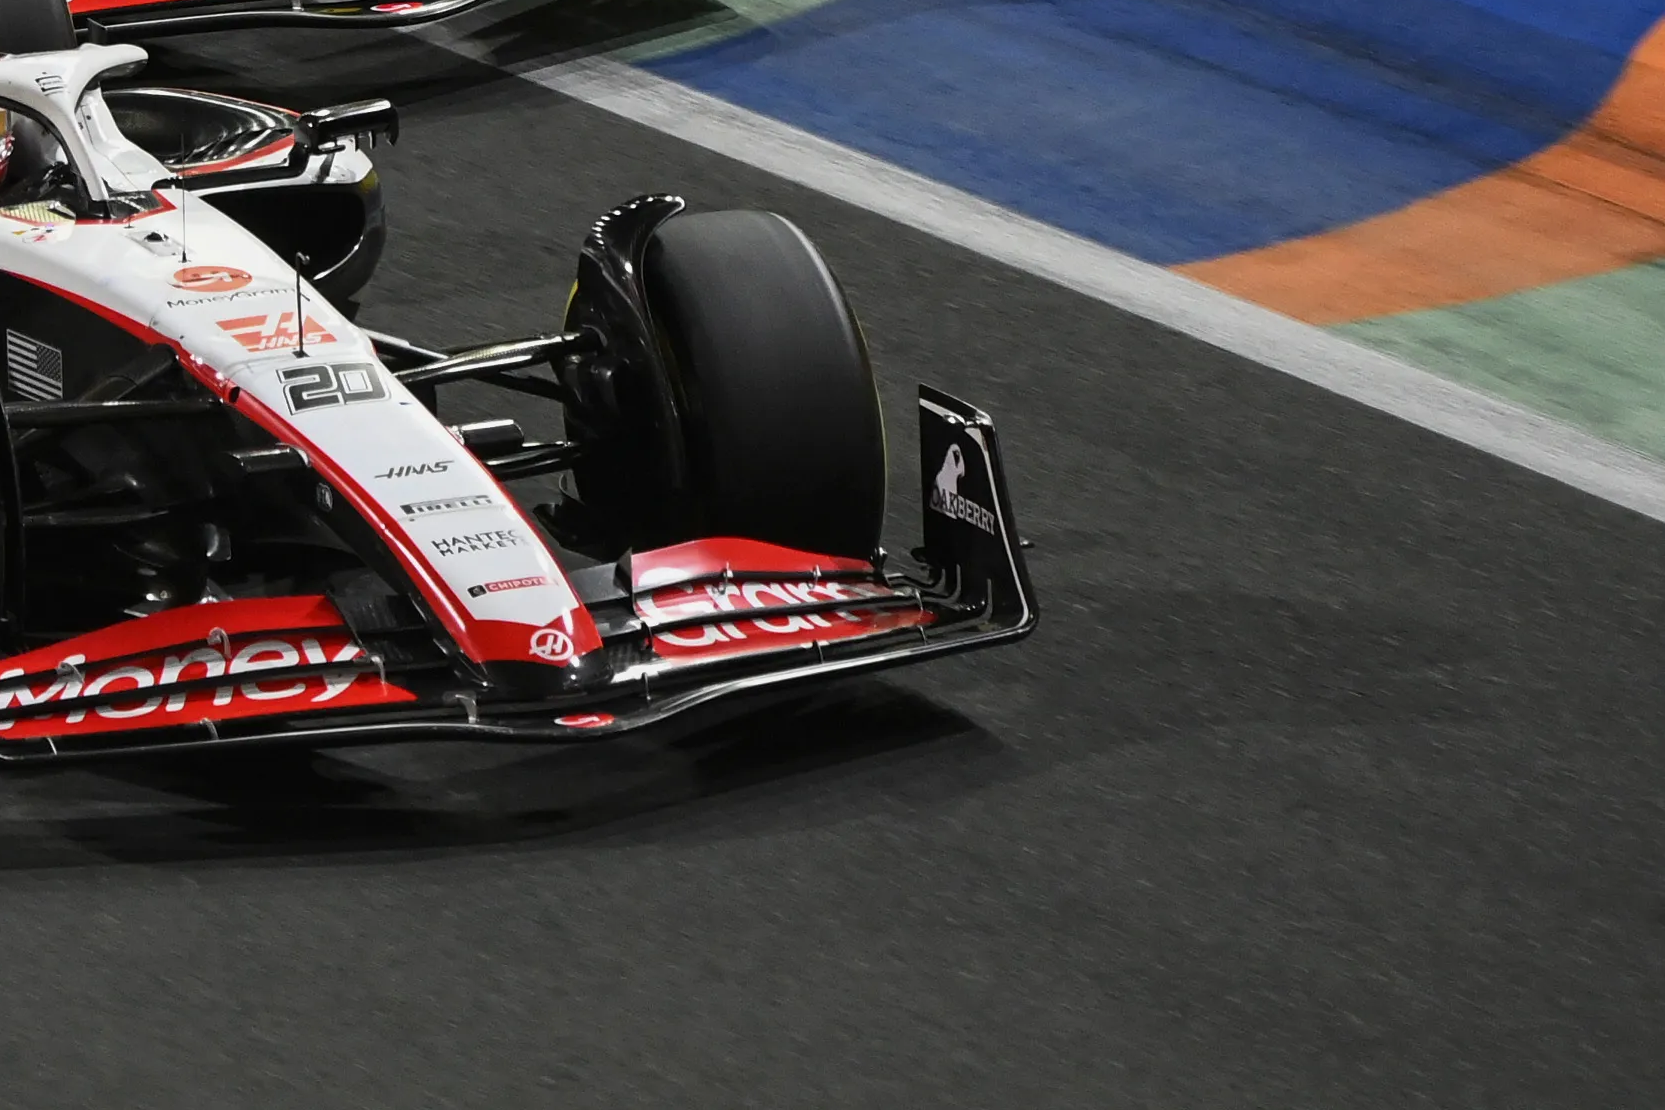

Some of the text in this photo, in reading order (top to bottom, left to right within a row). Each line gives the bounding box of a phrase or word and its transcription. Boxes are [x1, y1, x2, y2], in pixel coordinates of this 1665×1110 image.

[167, 288, 295, 308] MoneyGram
[275, 361, 391, 416] 20
[374, 460, 455, 479] HAAS
[930, 487, 995, 536] OAKBERRY
[431, 529, 522, 550] HANTEC
[438, 538, 530, 557] MARKET
